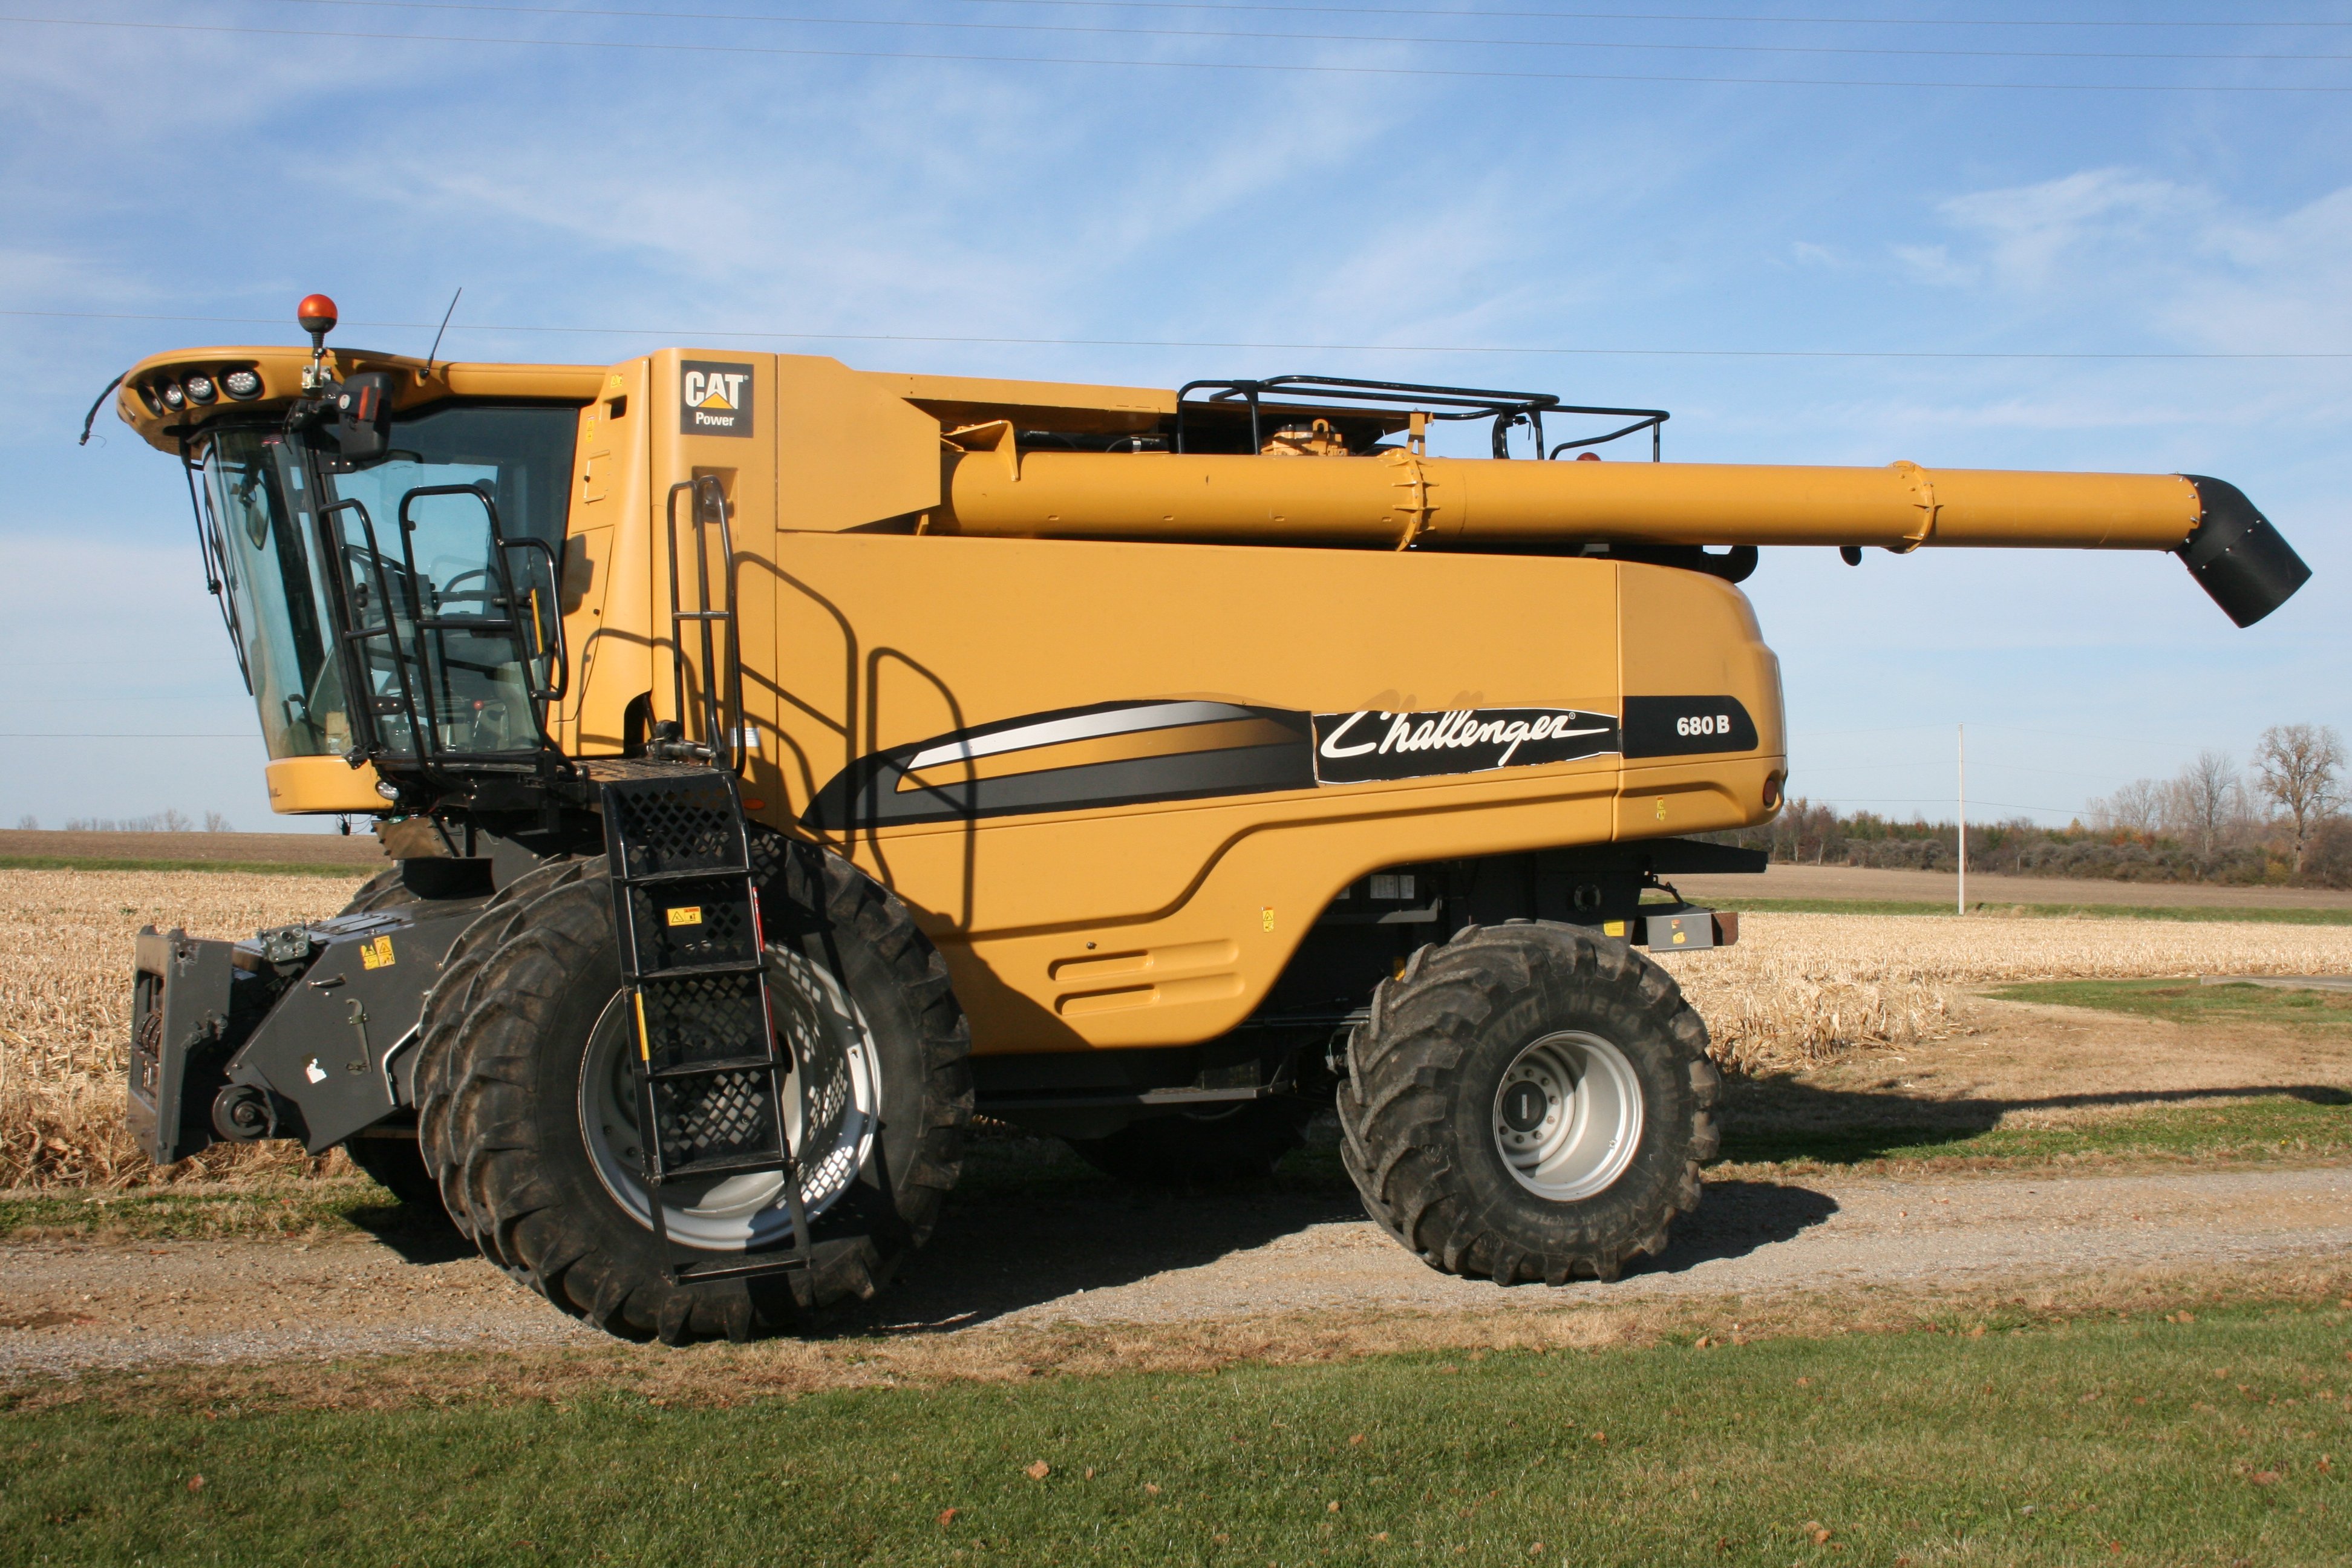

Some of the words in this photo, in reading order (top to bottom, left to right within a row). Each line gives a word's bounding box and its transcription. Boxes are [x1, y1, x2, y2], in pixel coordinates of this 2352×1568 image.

[685, 371, 743, 410] CAT
[696, 412, 734, 426] Power
[1320, 710, 1610, 766] Challenger
